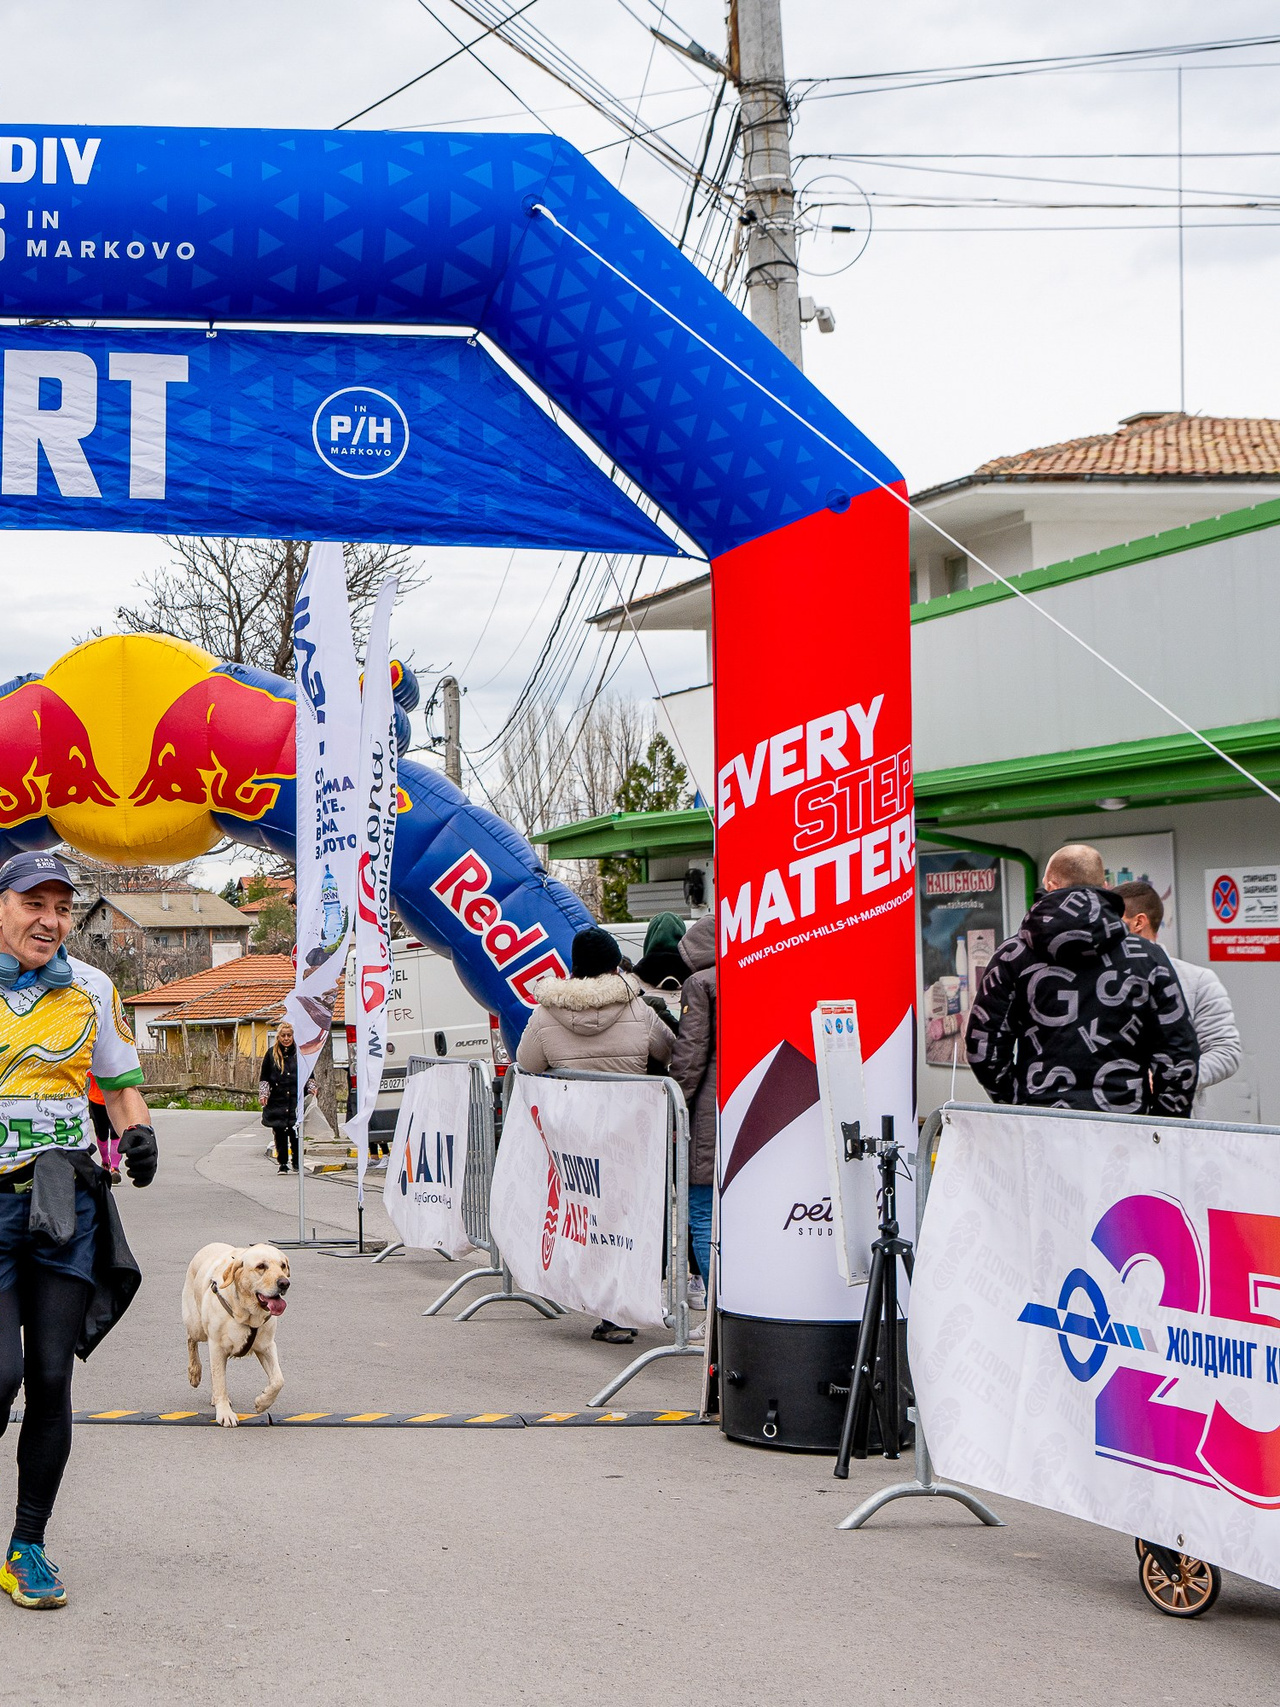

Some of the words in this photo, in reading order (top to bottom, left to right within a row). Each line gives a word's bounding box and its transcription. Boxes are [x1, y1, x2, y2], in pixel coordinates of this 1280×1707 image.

[26, 210, 60, 229] IN
[26, 238, 196, 261] MARKOVO
[354, 405, 367, 413] IN
[330, 415, 392, 446] P/H
[330, 447, 392, 457] MARKOVO
[718, 693, 885, 830] EVERY
[793, 744, 913, 852] STEP
[926, 868, 996, 895] НАШЕНСКО
[430, 848, 549, 972] Red
[738, 886, 914, 969] WWW.PLOVDIV-HILLS-IN-MARKOVO.COM
[562, 1199, 589, 1247] HILLS
[589, 1213, 597, 1226] IN
[798, 1228, 833, 1236] STUD
[590, 1232, 634, 1251] MARKOVO
[1166, 1326, 1258, 1379] ХОЛДИНГ
